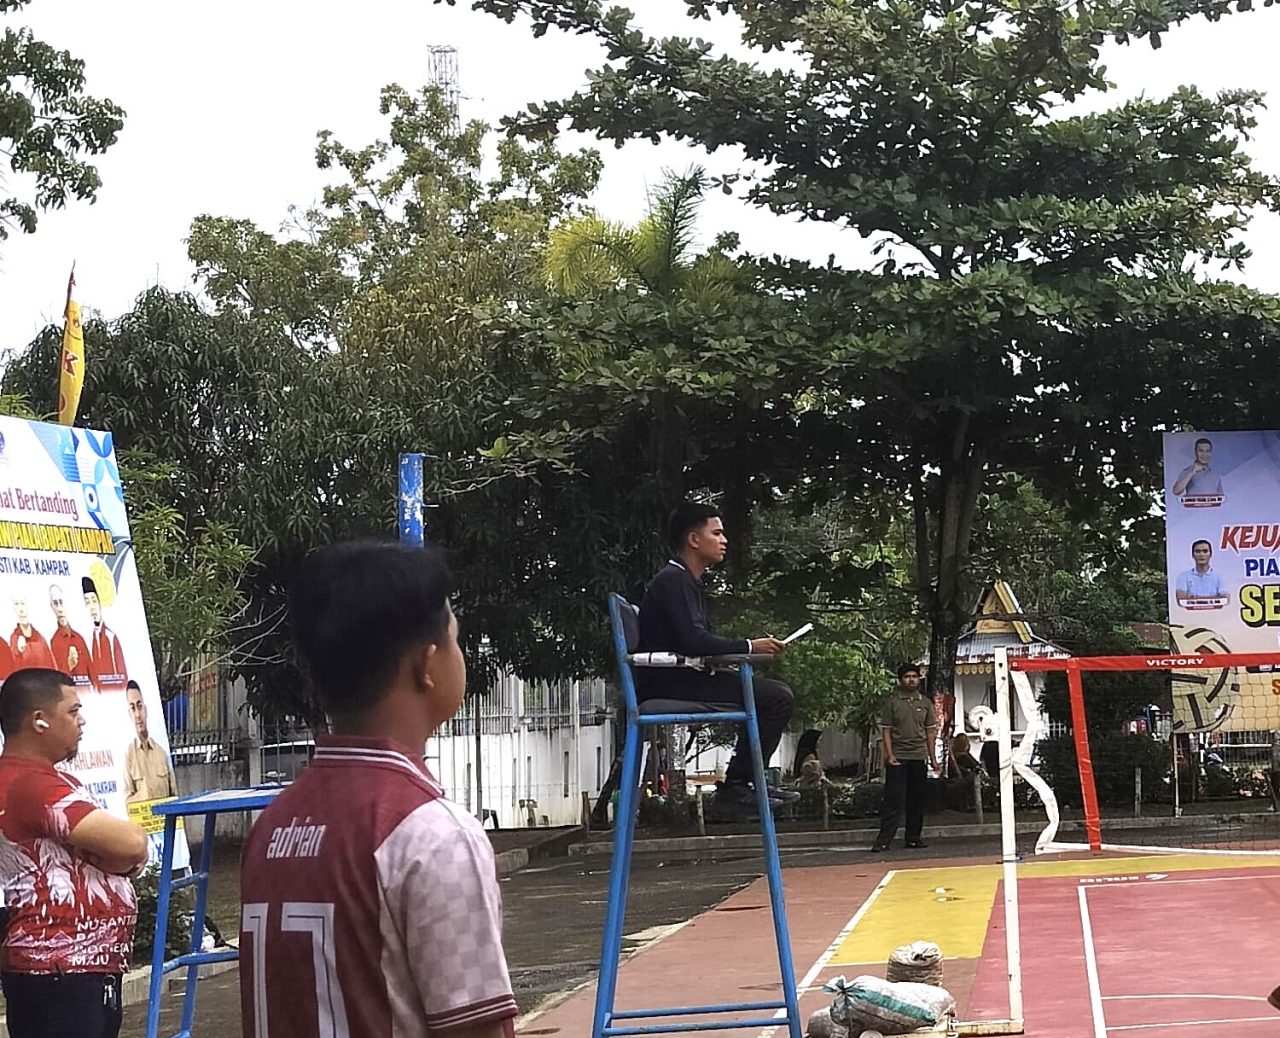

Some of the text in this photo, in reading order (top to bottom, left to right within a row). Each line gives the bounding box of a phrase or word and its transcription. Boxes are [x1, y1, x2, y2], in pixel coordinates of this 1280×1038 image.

[15, 488, 79, 521] Bertanding
[10, 521, 43, 551] PIALA
[39, 523, 77, 553] BUPATI
[73, 526, 116, 556] KAMPAR
[13, 558, 34, 576] KAB.
[35, 559, 70, 577] KAMPAR
[1147, 658, 1204, 666] VICTORY
[266, 815, 327, 860] adrian
